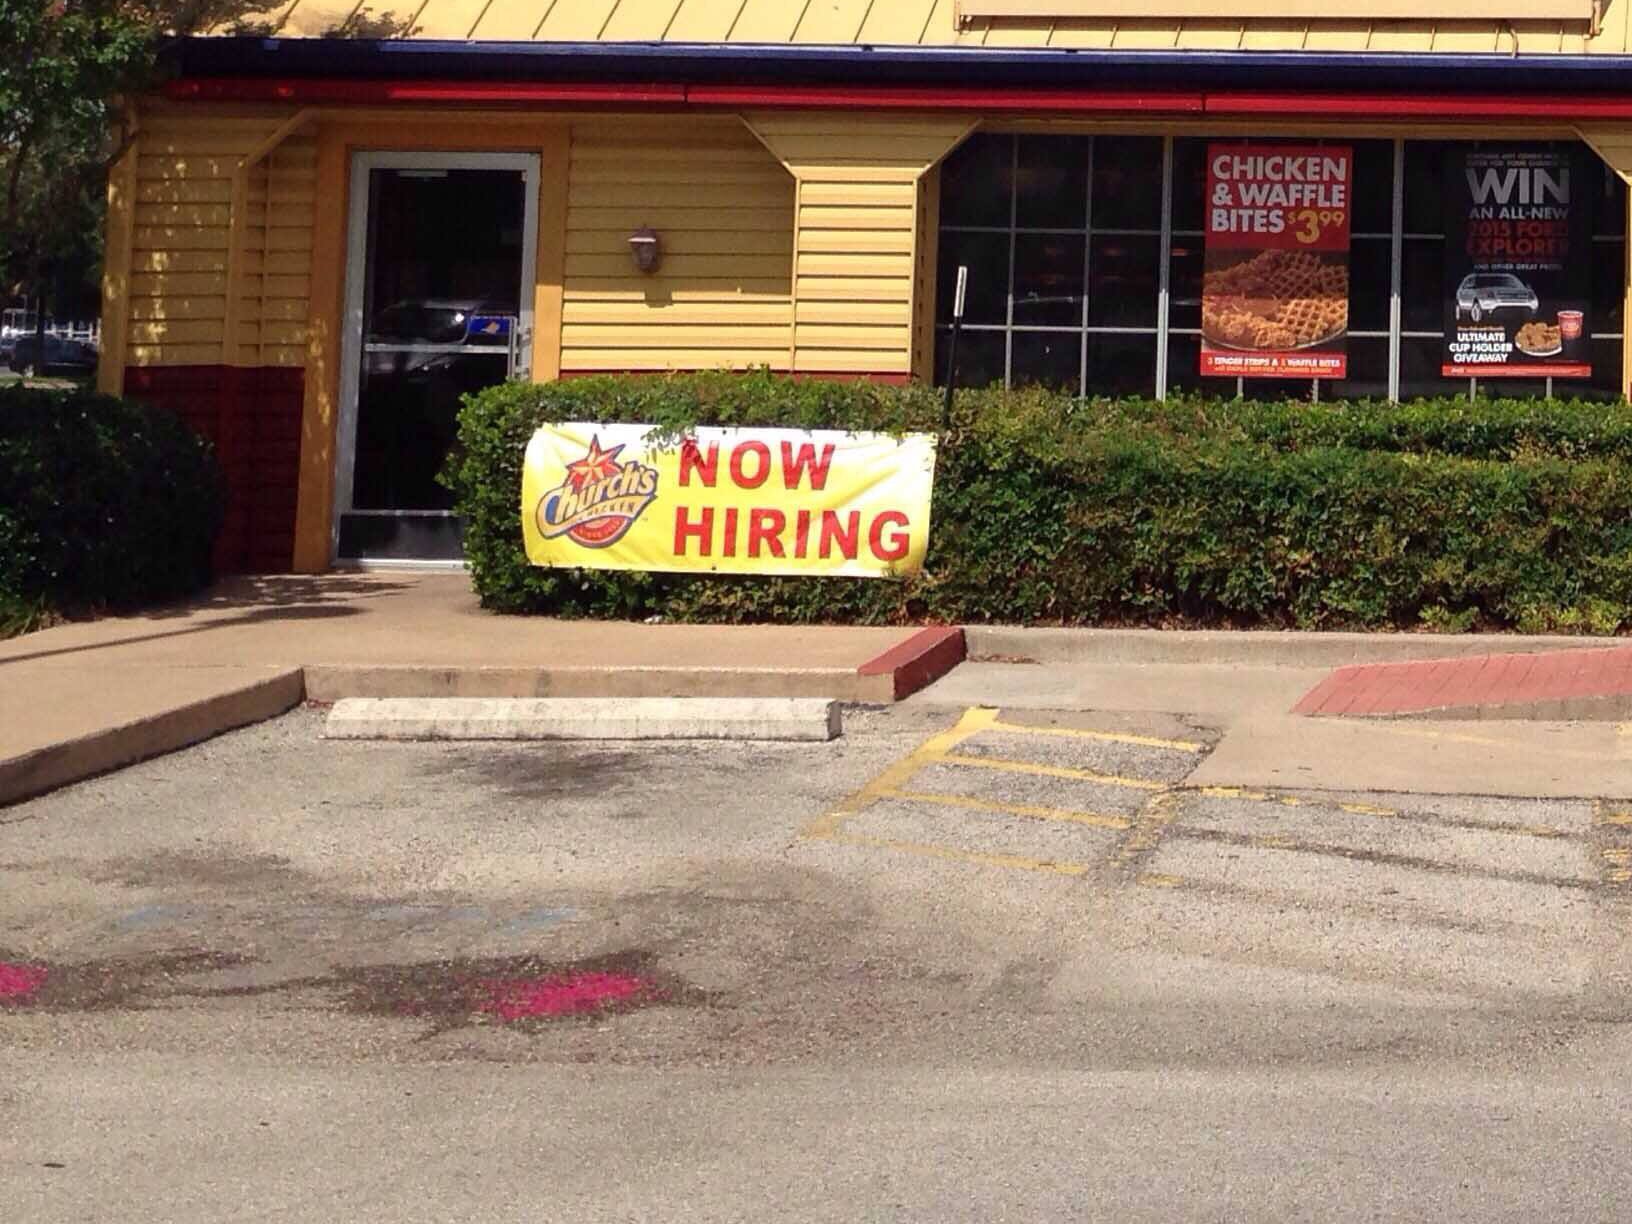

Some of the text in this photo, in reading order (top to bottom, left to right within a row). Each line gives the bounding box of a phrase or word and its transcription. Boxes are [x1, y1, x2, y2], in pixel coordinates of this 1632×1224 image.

[1212, 155, 1347, 181] CHICKEN
[1212, 183, 1345, 208] & WAFFLE
[1465, 168, 1570, 204] WIN
[1212, 209, 1285, 233] BITES
[1469, 208, 1568, 220] AN ALL-NEW
[1517, 222, 1569, 238] FO
[1449, 343, 1513, 352] CUP HOLDER
[1457, 332, 1506, 342] ULTIMATE
[1453, 353, 1509, 363] GIVEAWAY
[678, 440, 836, 491] NOW
[537, 463, 656, 536] Church's
[673, 506, 911, 561] HIRING
